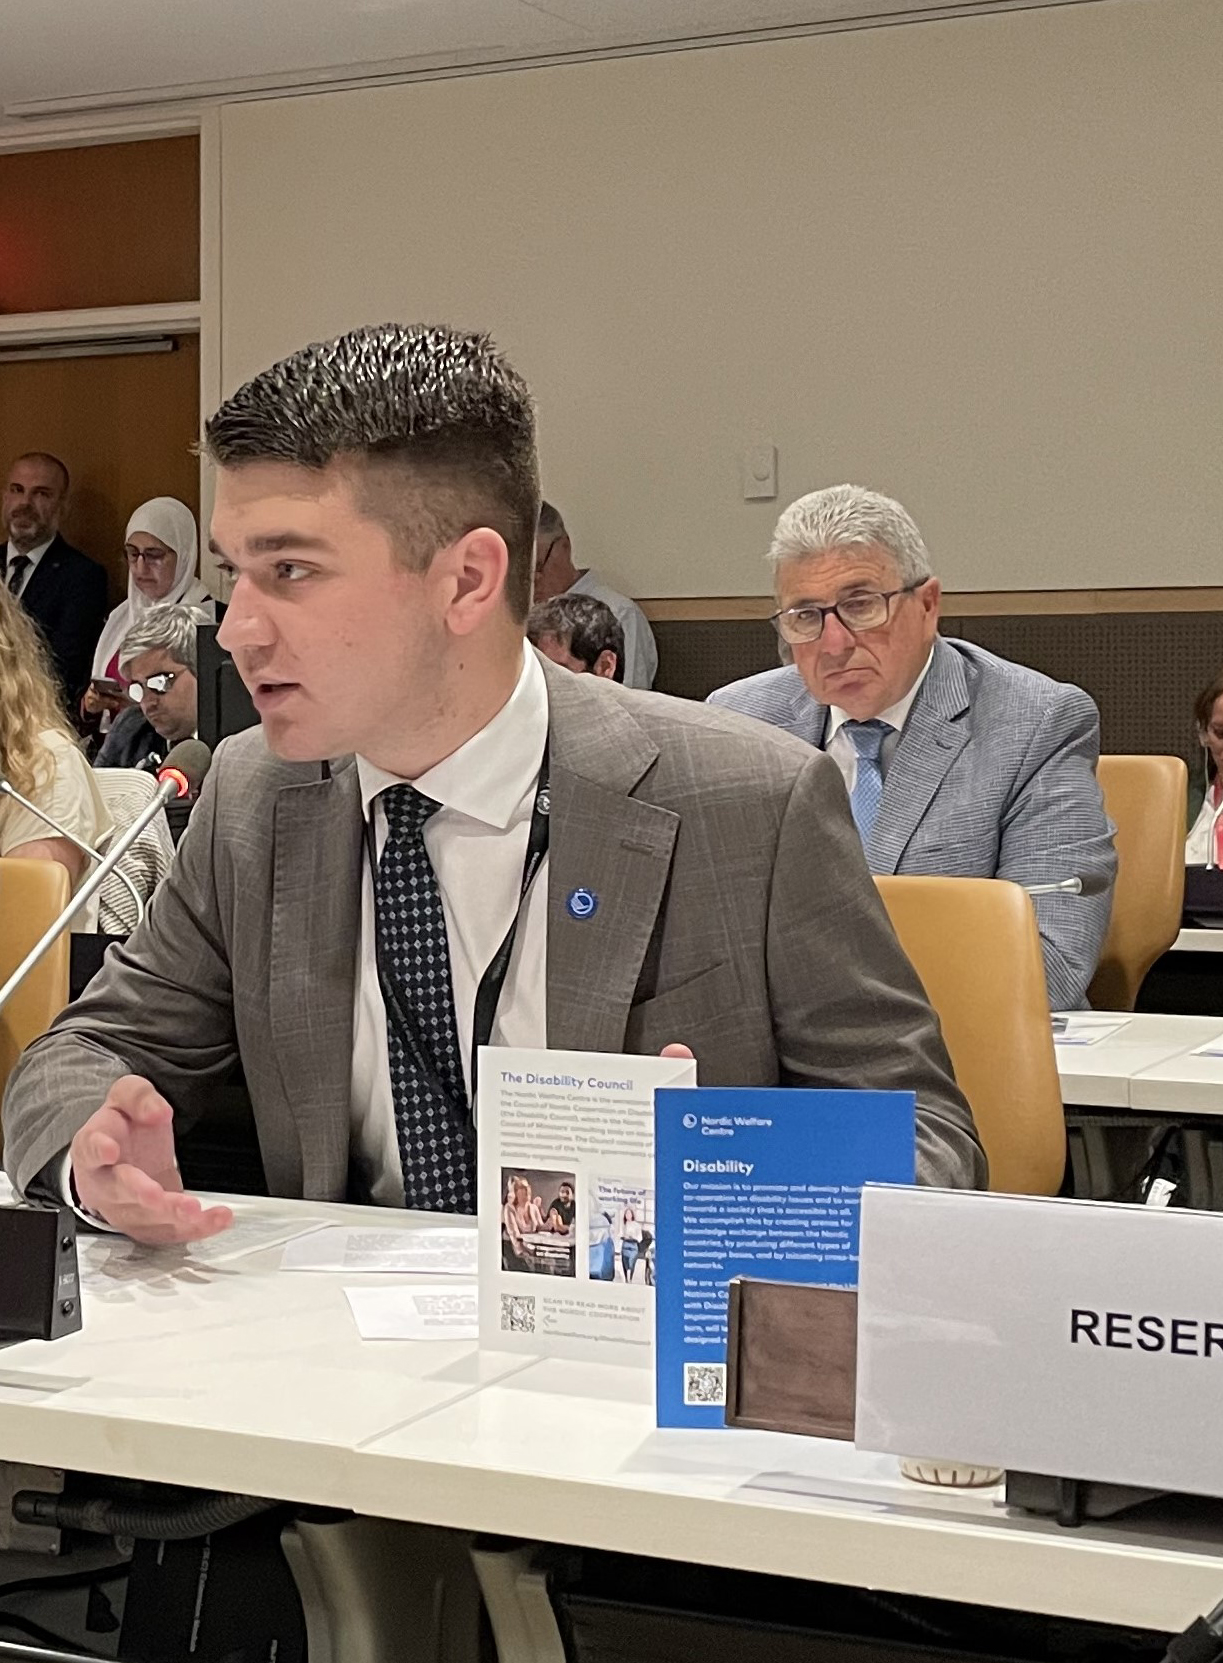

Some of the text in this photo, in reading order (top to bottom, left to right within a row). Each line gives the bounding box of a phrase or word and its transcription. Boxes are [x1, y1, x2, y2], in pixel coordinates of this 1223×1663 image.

[501, 1072, 634, 1091] The Disability Council
[701, 1116, 733, 1126] Nordic
[683, 1159, 755, 1177] Disability
[598, 1185, 611, 1193] The
[1070, 1308, 1223, 1358] RESER
